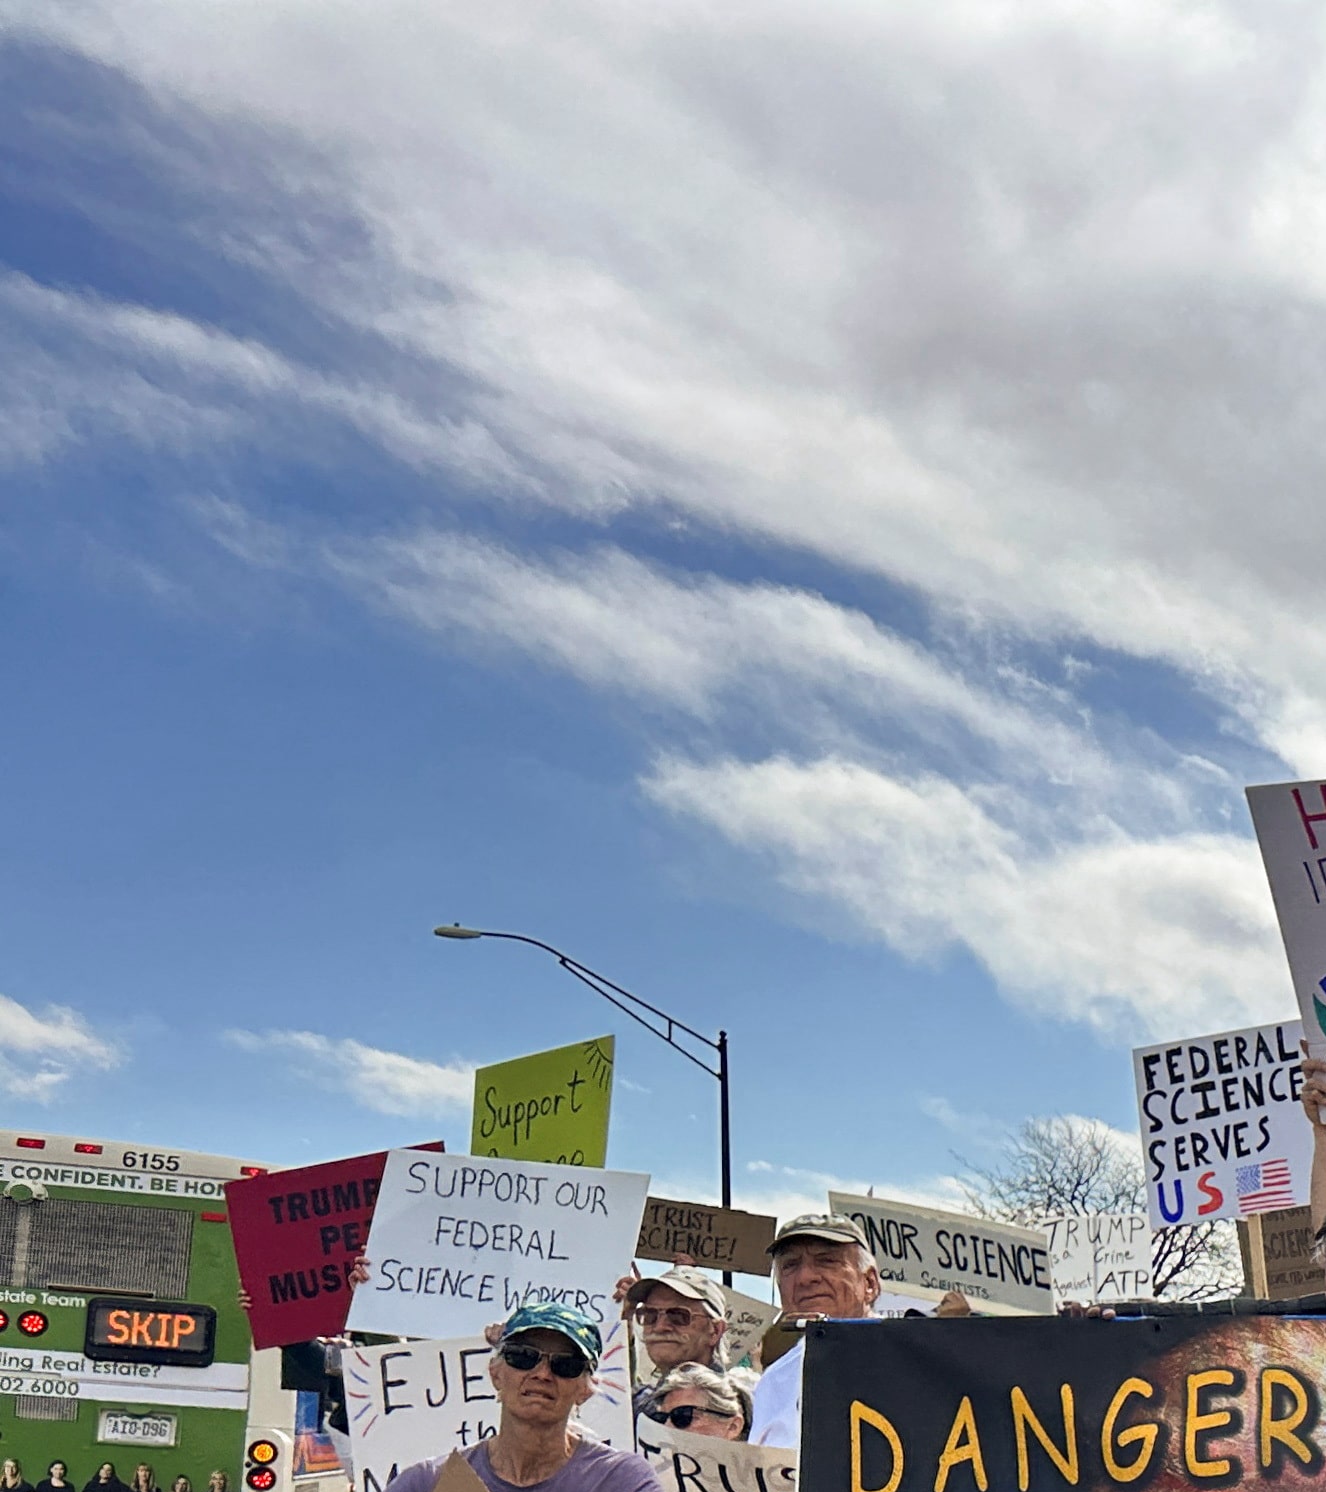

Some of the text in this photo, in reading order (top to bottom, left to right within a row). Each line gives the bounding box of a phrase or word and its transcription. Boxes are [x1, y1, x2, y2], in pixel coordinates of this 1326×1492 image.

[1142, 1026, 1301, 1092] FEDERAL
[481, 1070, 585, 1145] Support
[1142, 1071, 1305, 1133] SCIENCE
[122, 1151, 181, 1171] 6155
[1148, 1116, 1272, 1182] SERVES
[11, 1164, 143, 1190] CONFIDENT.
[150, 1178, 177, 1192] BE
[405, 1161, 609, 1217] SUPPORT OUR
[435, 1216, 570, 1261] FEDERAL
[650, 1204, 718, 1233] TRUST
[1043, 1216, 1146, 1252] TRUMP
[638, 1225, 737, 1262] SCIENCE!
[845, 1212, 1052, 1290] ONOR SCIENCE
[41, 1292, 86, 1308] Team
[376, 1259, 495, 1303] SCIENCE
[920, 1271, 990, 1300] SCIENTISTS
[1097, 1269, 1150, 1296] ATP
[106, 1309, 197, 1349] SKIP
[42, 1355, 85, 1372] Real
[92, 1360, 162, 1379] Estate?
[380, 1346, 498, 1416] EJE
